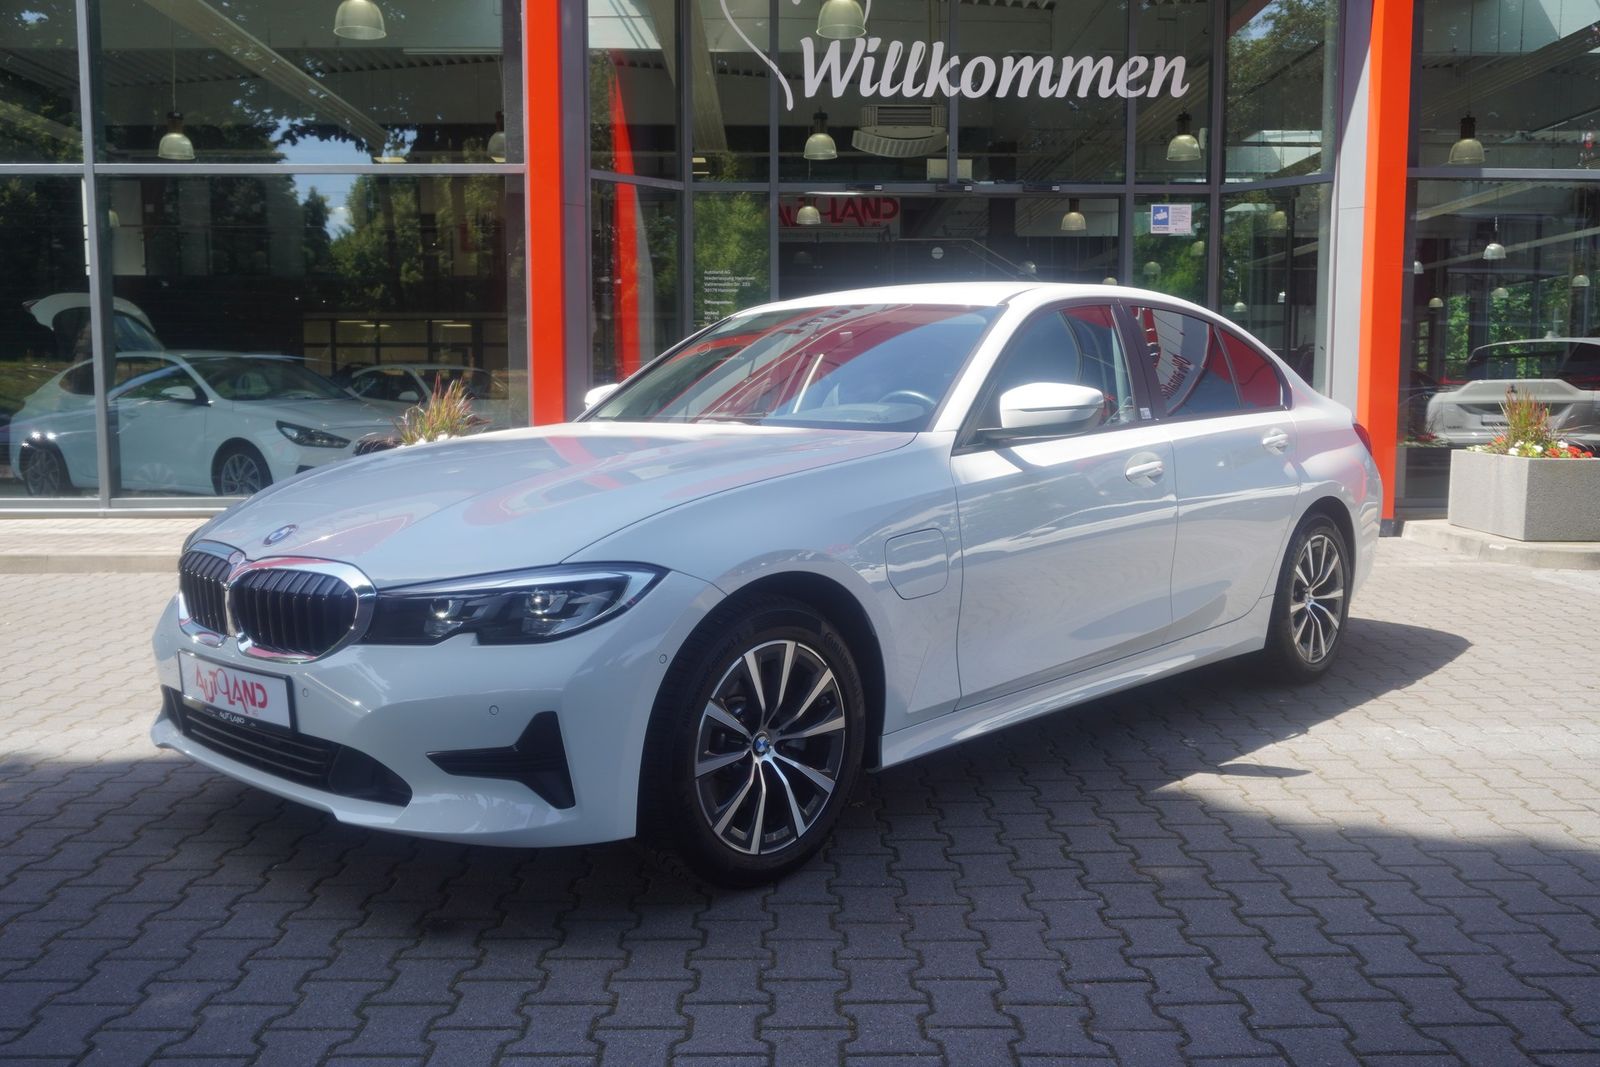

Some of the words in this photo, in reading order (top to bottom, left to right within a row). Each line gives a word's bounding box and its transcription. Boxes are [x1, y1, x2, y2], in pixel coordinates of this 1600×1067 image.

[800, 37, 1189, 99] Willkommen
[196, 663, 268, 713] AUTOLAND
[219, 711, 245, 724] AUTLAND
